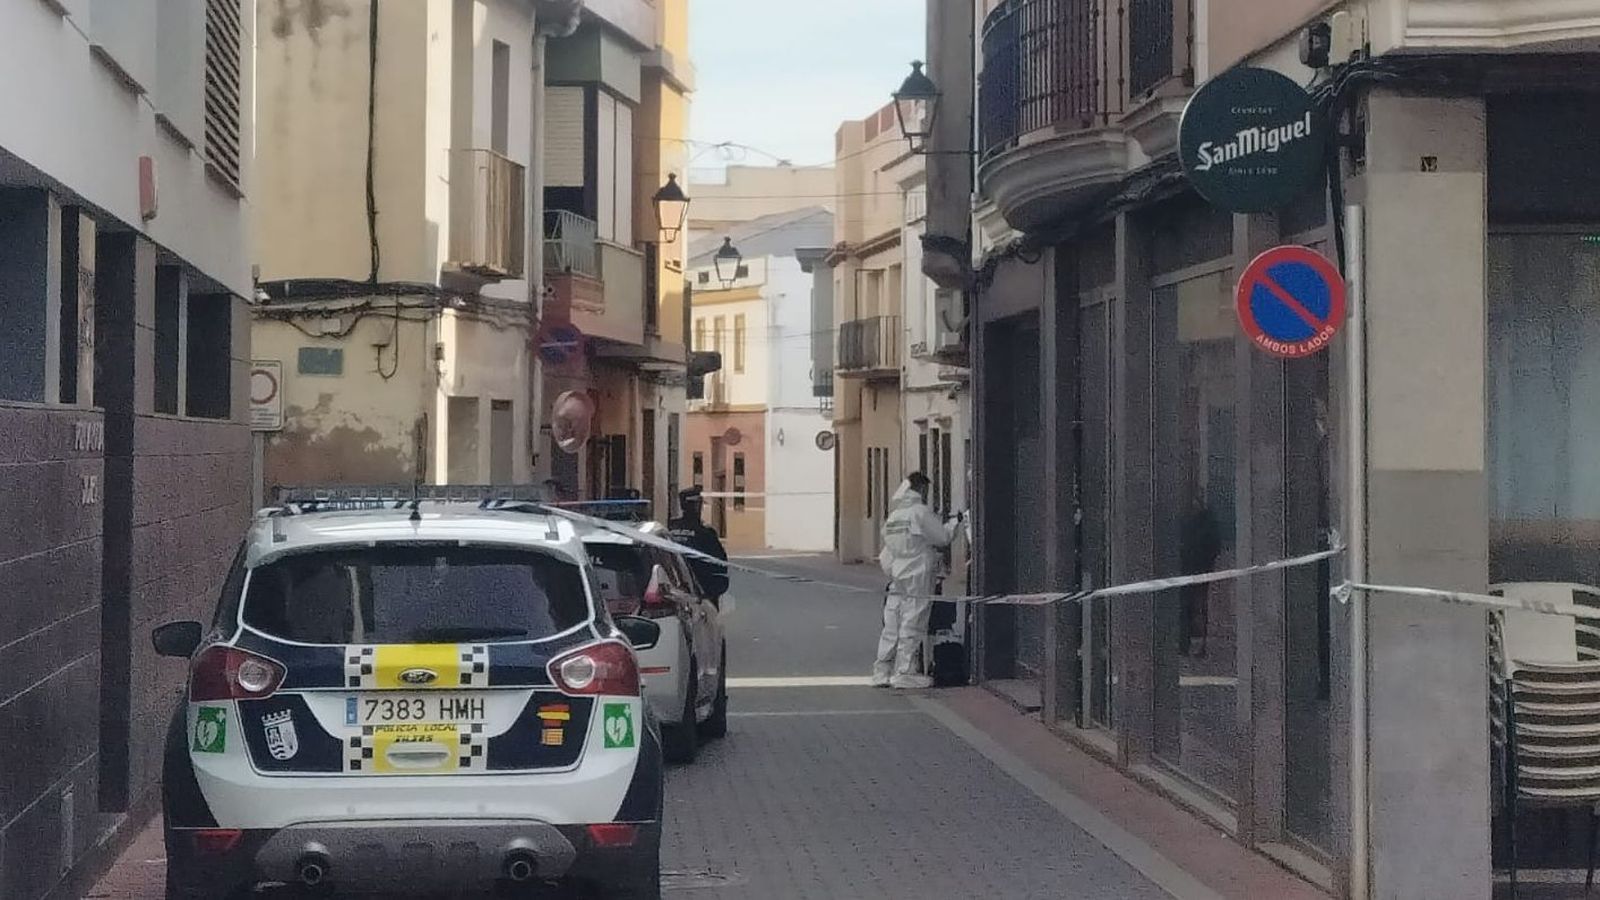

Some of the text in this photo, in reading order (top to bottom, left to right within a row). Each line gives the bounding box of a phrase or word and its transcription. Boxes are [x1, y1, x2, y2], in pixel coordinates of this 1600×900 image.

[1256, 325, 1336, 354] AMBOS LADOS
[365, 699, 426, 721] 7383
[439, 698, 485, 720] HMH
